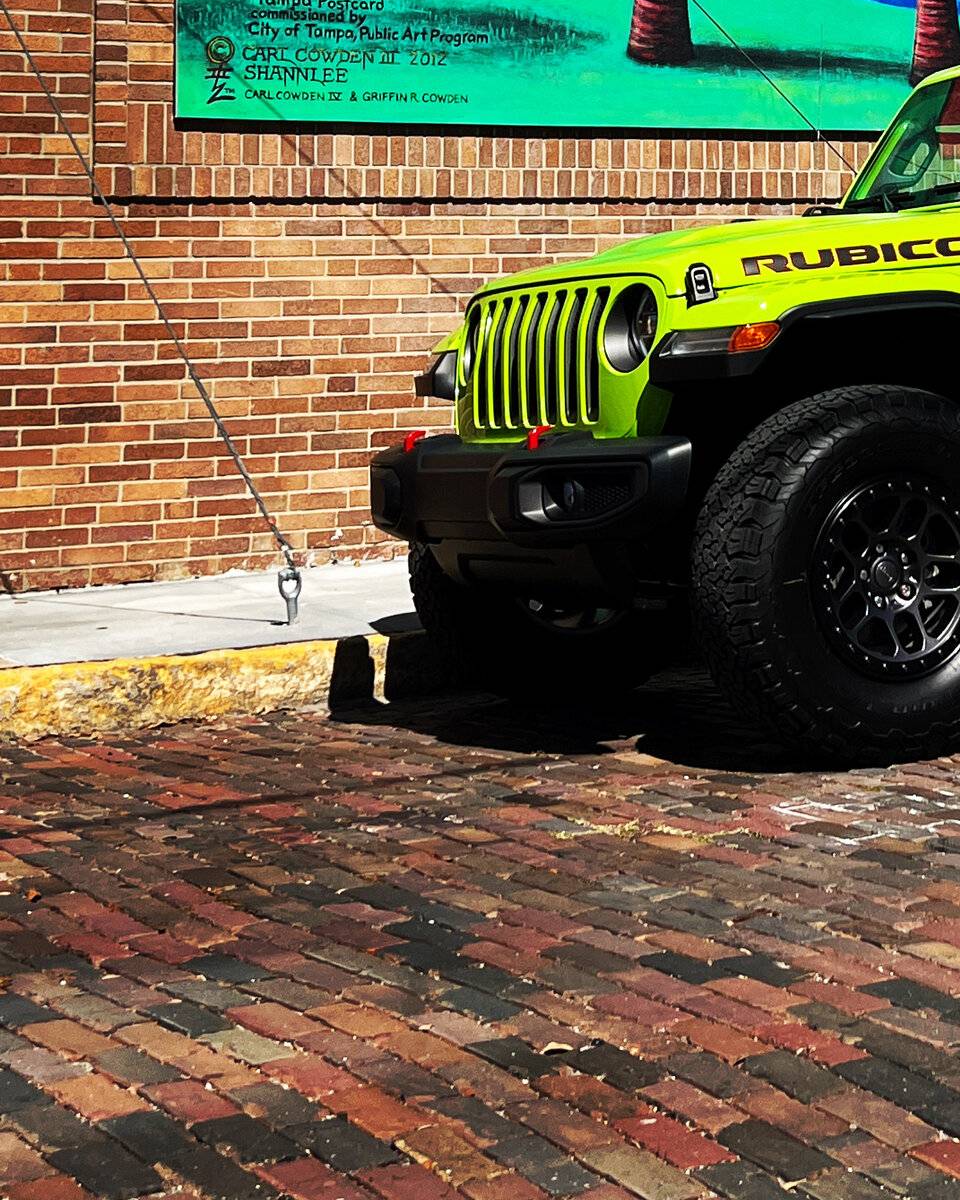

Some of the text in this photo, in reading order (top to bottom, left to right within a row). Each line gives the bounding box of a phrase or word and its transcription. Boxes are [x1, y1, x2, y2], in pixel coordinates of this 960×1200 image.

[250, 7, 367, 28] commissioned by
[247, 20, 489, 47] City of Tampa, Public Art Program
[242, 45, 297, 67] CARL
[294, 46, 376, 71] COWDEN
[409, 49, 448, 67] 2012
[244, 88, 275, 100] CARL
[275, 90, 325, 101] COWDEN
[362, 91, 408, 103] GRIFFIN
[422, 92, 469, 104] COWDEN
